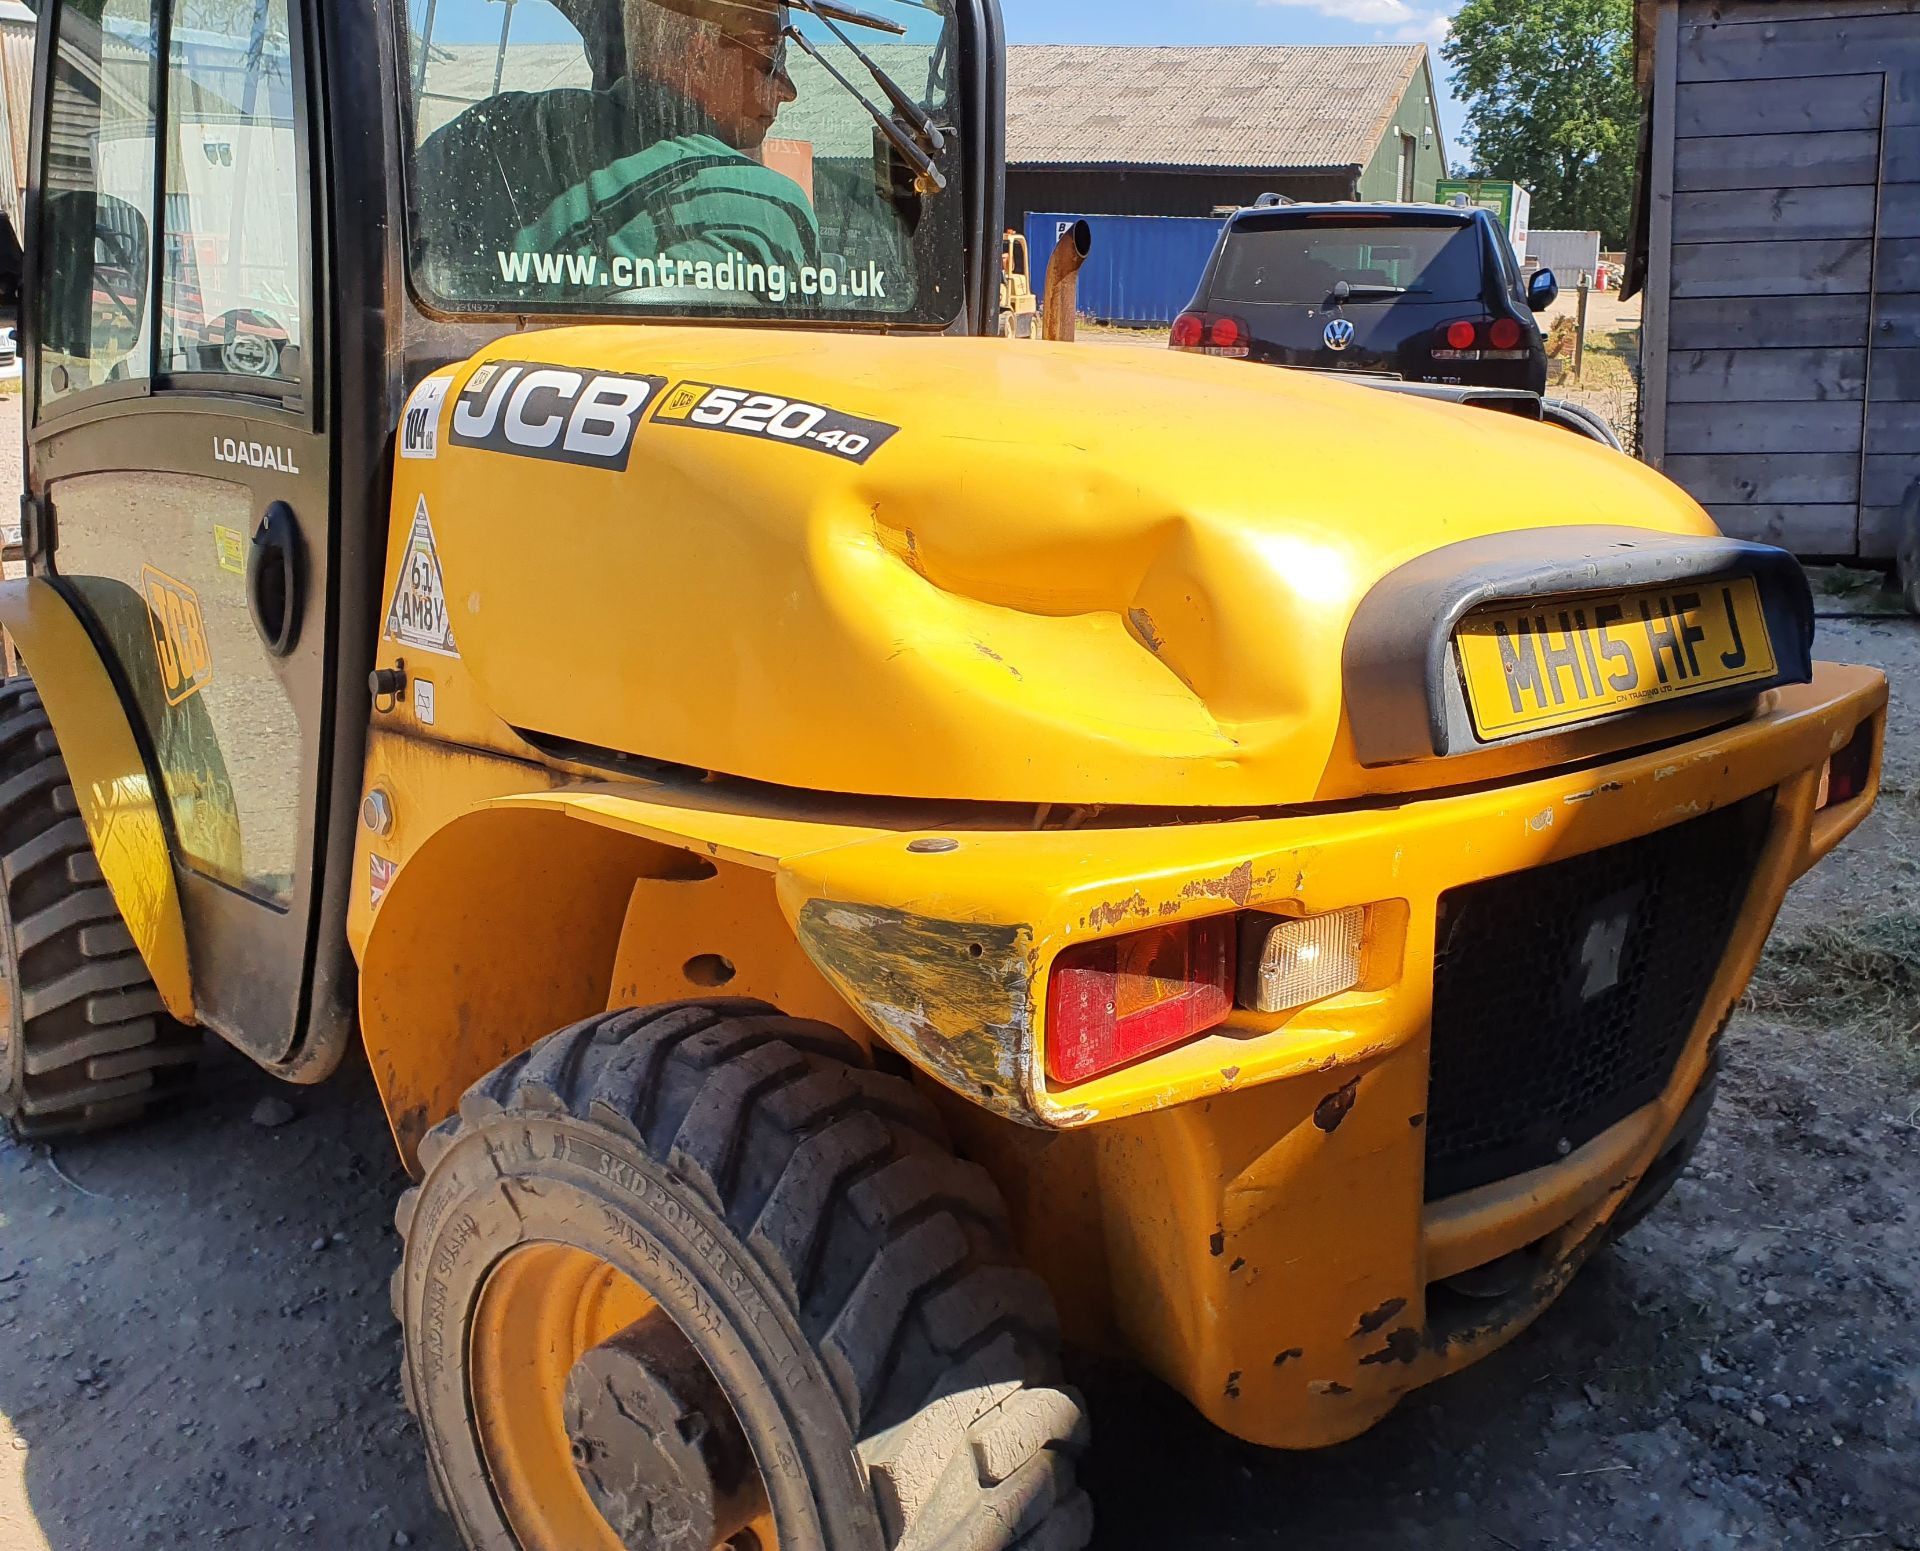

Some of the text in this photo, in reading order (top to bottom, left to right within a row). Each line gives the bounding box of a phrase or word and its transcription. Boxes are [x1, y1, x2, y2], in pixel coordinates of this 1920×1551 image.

[497, 251, 885, 301] www.cntrading.co.uk
[454, 367, 650, 457] JCB
[671, 390, 694, 408] JCB
[691, 388, 869, 455] 520-40
[405, 408, 429, 450] 104
[213, 436, 299, 474] LOADALL
[151, 582, 205, 690] JCB
[402, 591, 443, 633] AM8Y
[1494, 588, 1746, 713] MH15 HFJ
[1616, 684, 1673, 703] CN TRADING LTD
[599, 1152, 648, 1198] SKID
[649, 1188, 727, 1276] POWER
